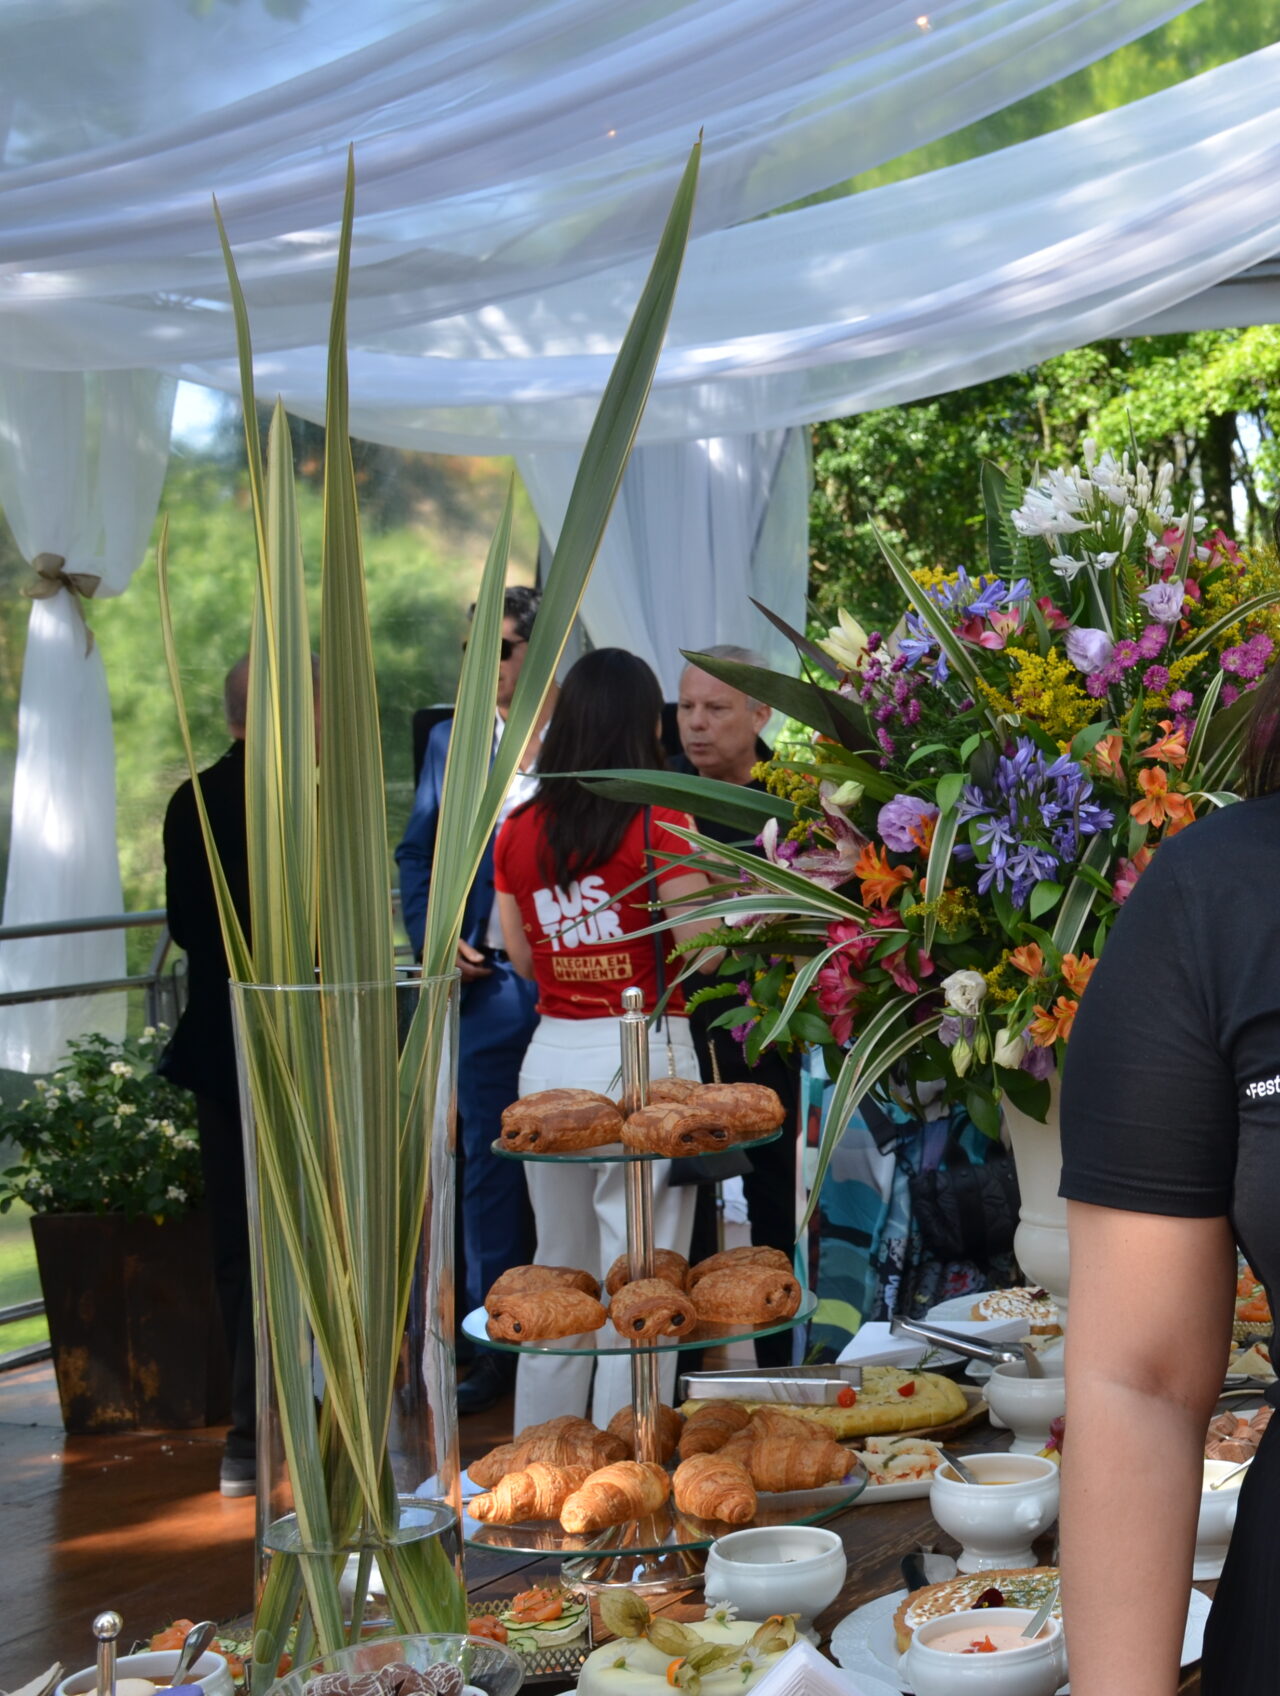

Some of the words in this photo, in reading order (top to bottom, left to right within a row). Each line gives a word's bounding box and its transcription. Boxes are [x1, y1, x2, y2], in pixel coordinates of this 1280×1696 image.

[533, 875, 611, 925] BUS
[541, 909, 624, 952] TOUR
[555, 957, 603, 969] ALEGRIA
[607, 955, 628, 967] EM
